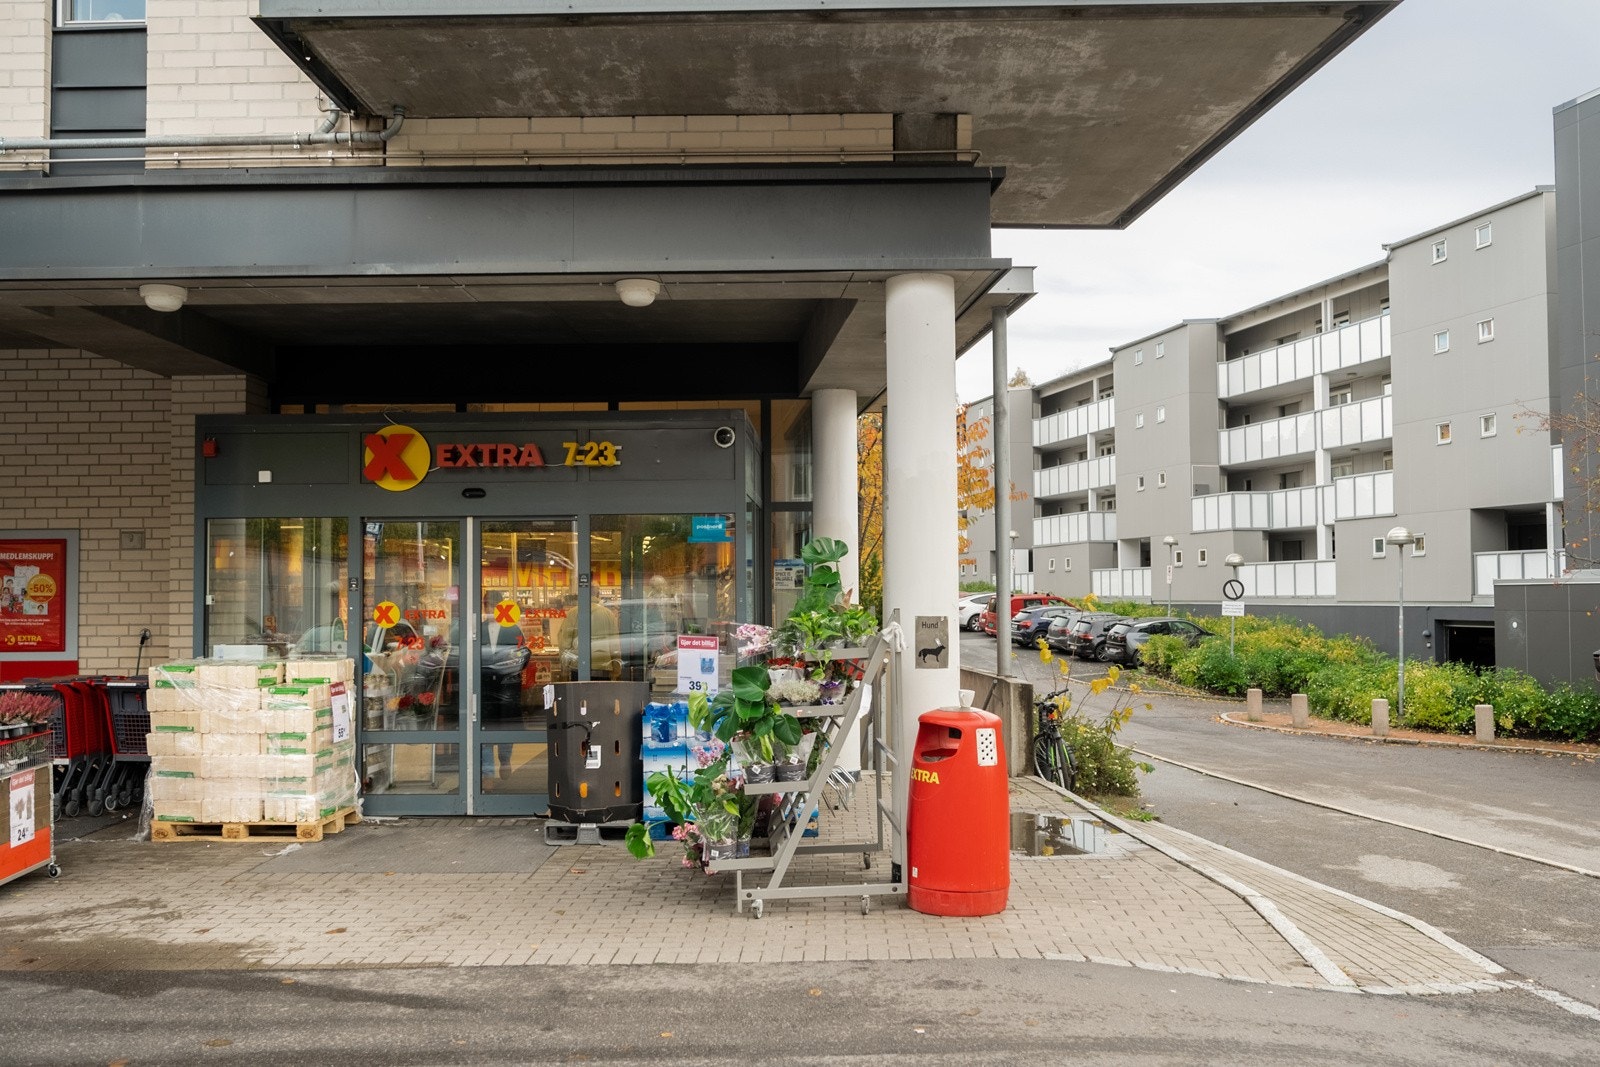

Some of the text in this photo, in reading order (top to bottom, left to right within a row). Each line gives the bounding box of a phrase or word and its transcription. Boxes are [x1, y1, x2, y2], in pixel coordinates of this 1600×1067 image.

[436, 443, 545, 468] EXTRA
[562, 441, 617, 467] 7-23
[0, 552, 54, 560] MEDLEMSKUPP!
[30, 584, 53, 593] -50%
[404, 609, 446, 619] EXTRA
[525, 608, 567, 618] EXTRA
[921, 621, 939, 629] Hund
